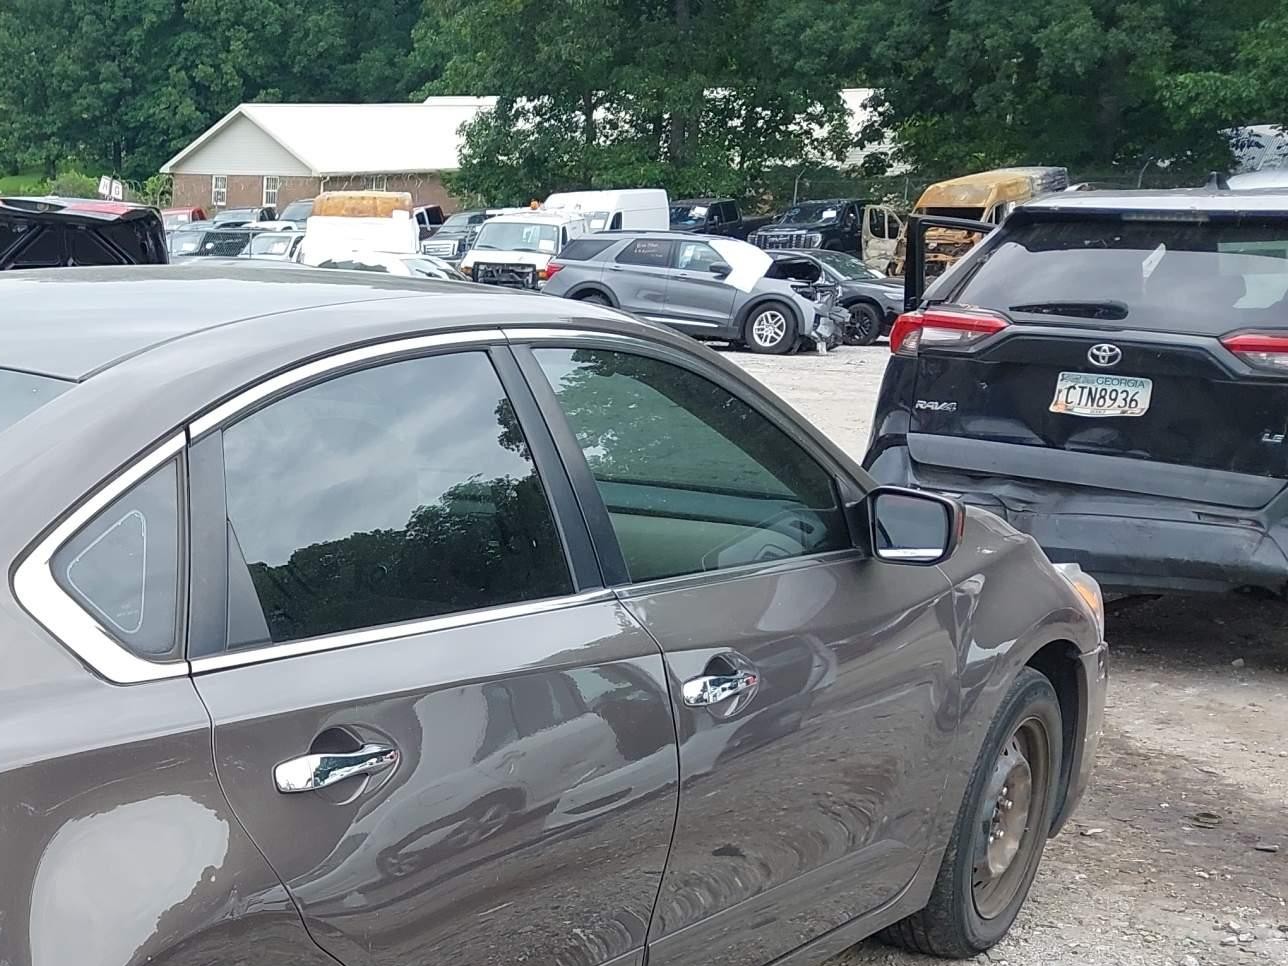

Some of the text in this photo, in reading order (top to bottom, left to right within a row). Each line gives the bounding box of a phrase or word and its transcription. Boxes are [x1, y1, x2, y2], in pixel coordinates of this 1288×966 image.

[1096, 376, 1145, 389] GEORGIA
[1064, 384, 1140, 410] CTN8936
[915, 400, 957, 411] RAV4
